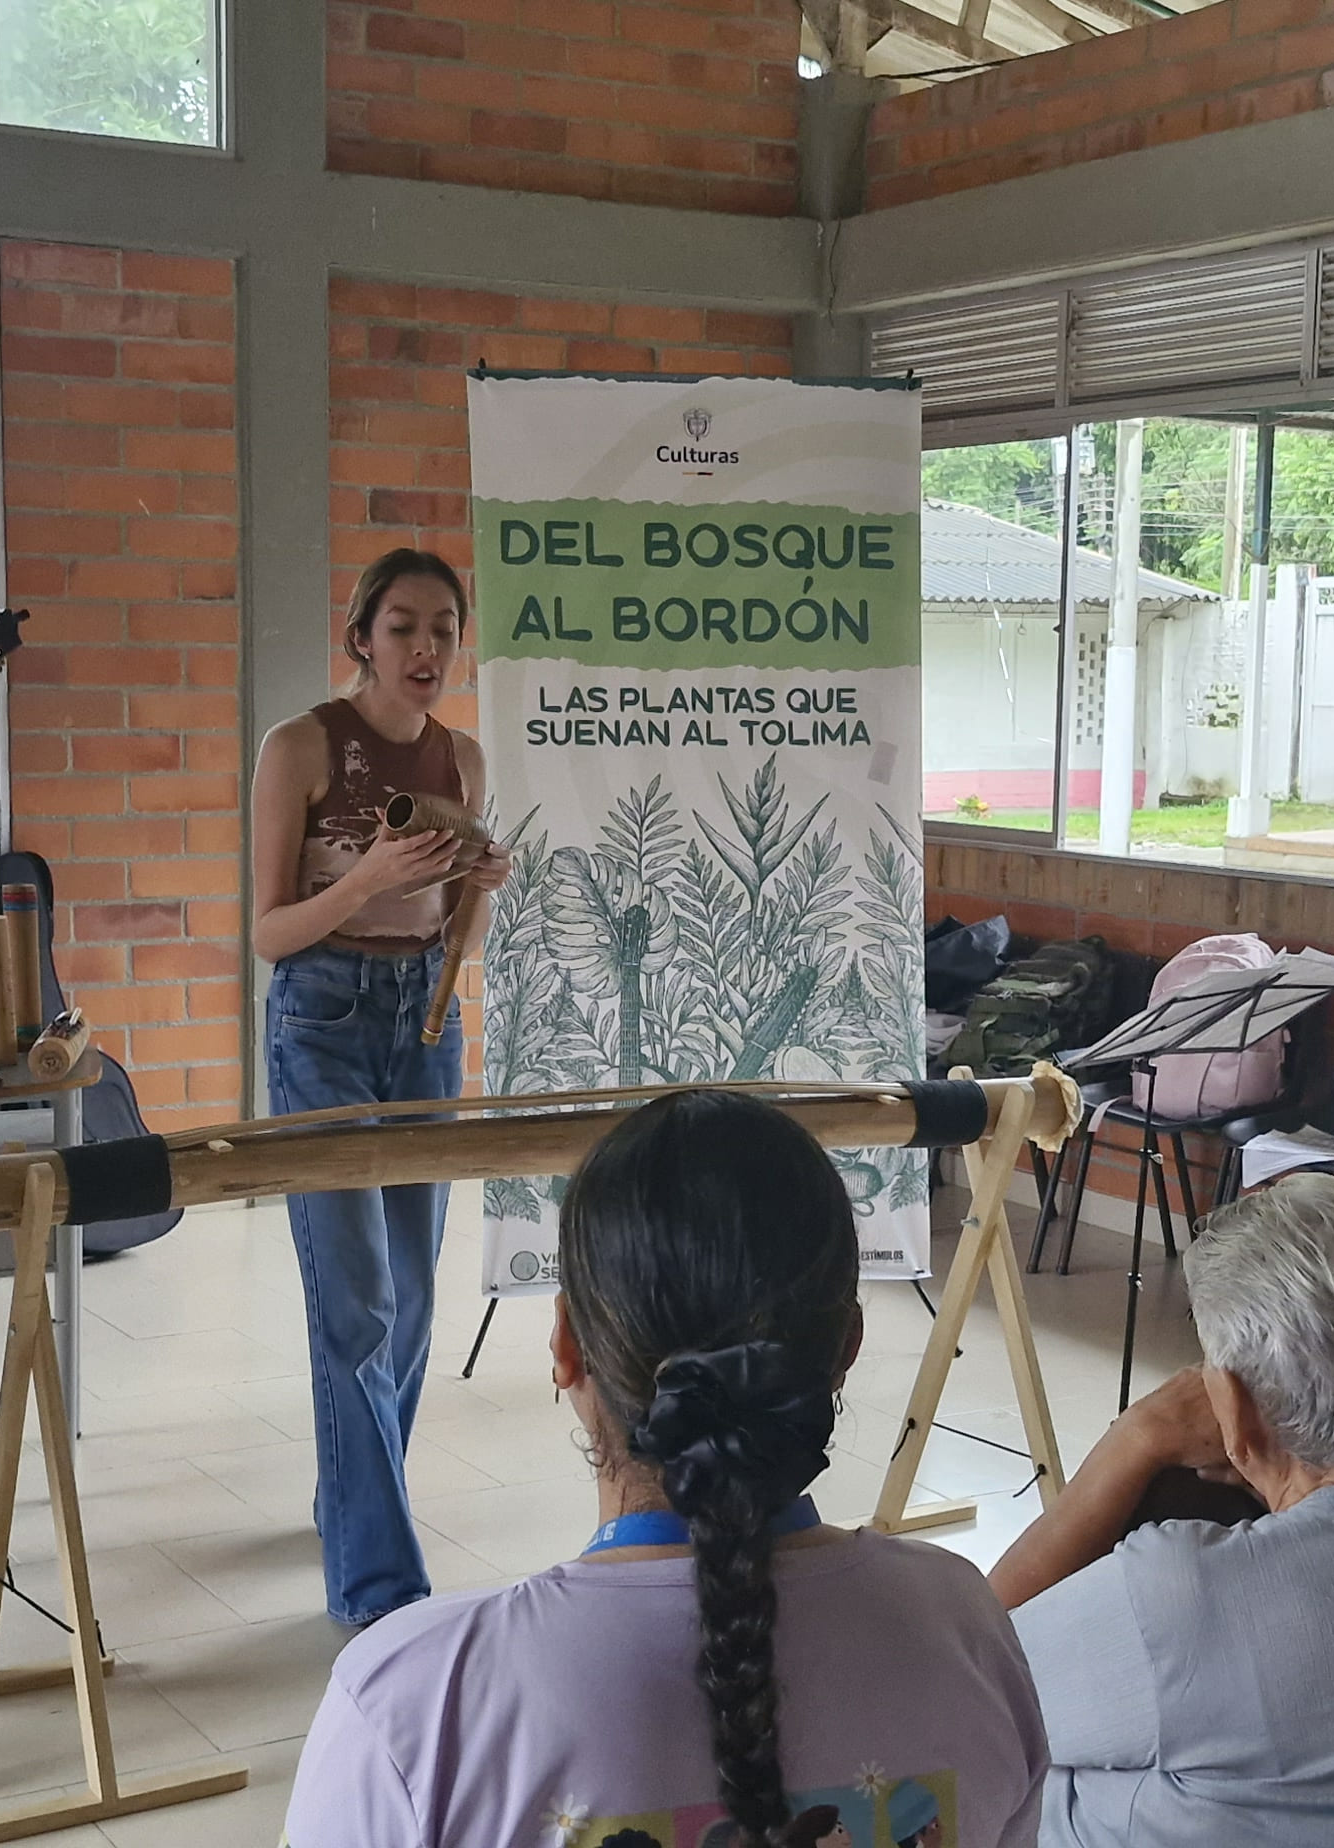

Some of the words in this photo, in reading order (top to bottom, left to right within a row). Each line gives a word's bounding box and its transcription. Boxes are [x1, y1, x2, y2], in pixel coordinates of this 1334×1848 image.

[656, 445, 740, 464] Culturas
[500, 519, 625, 568] DEL
[643, 522, 895, 570] BOSQUE
[511, 595, 593, 642] AL
[612, 575, 869, 645] BORDÓN
[539, 686, 609, 714] LAS
[619, 686, 776, 715] PLANTAS
[785, 687, 858, 714] QUE
[526, 719, 671, 748] SUENAN
[681, 719, 729, 747] AL
[739, 719, 871, 747] TOLIMA
